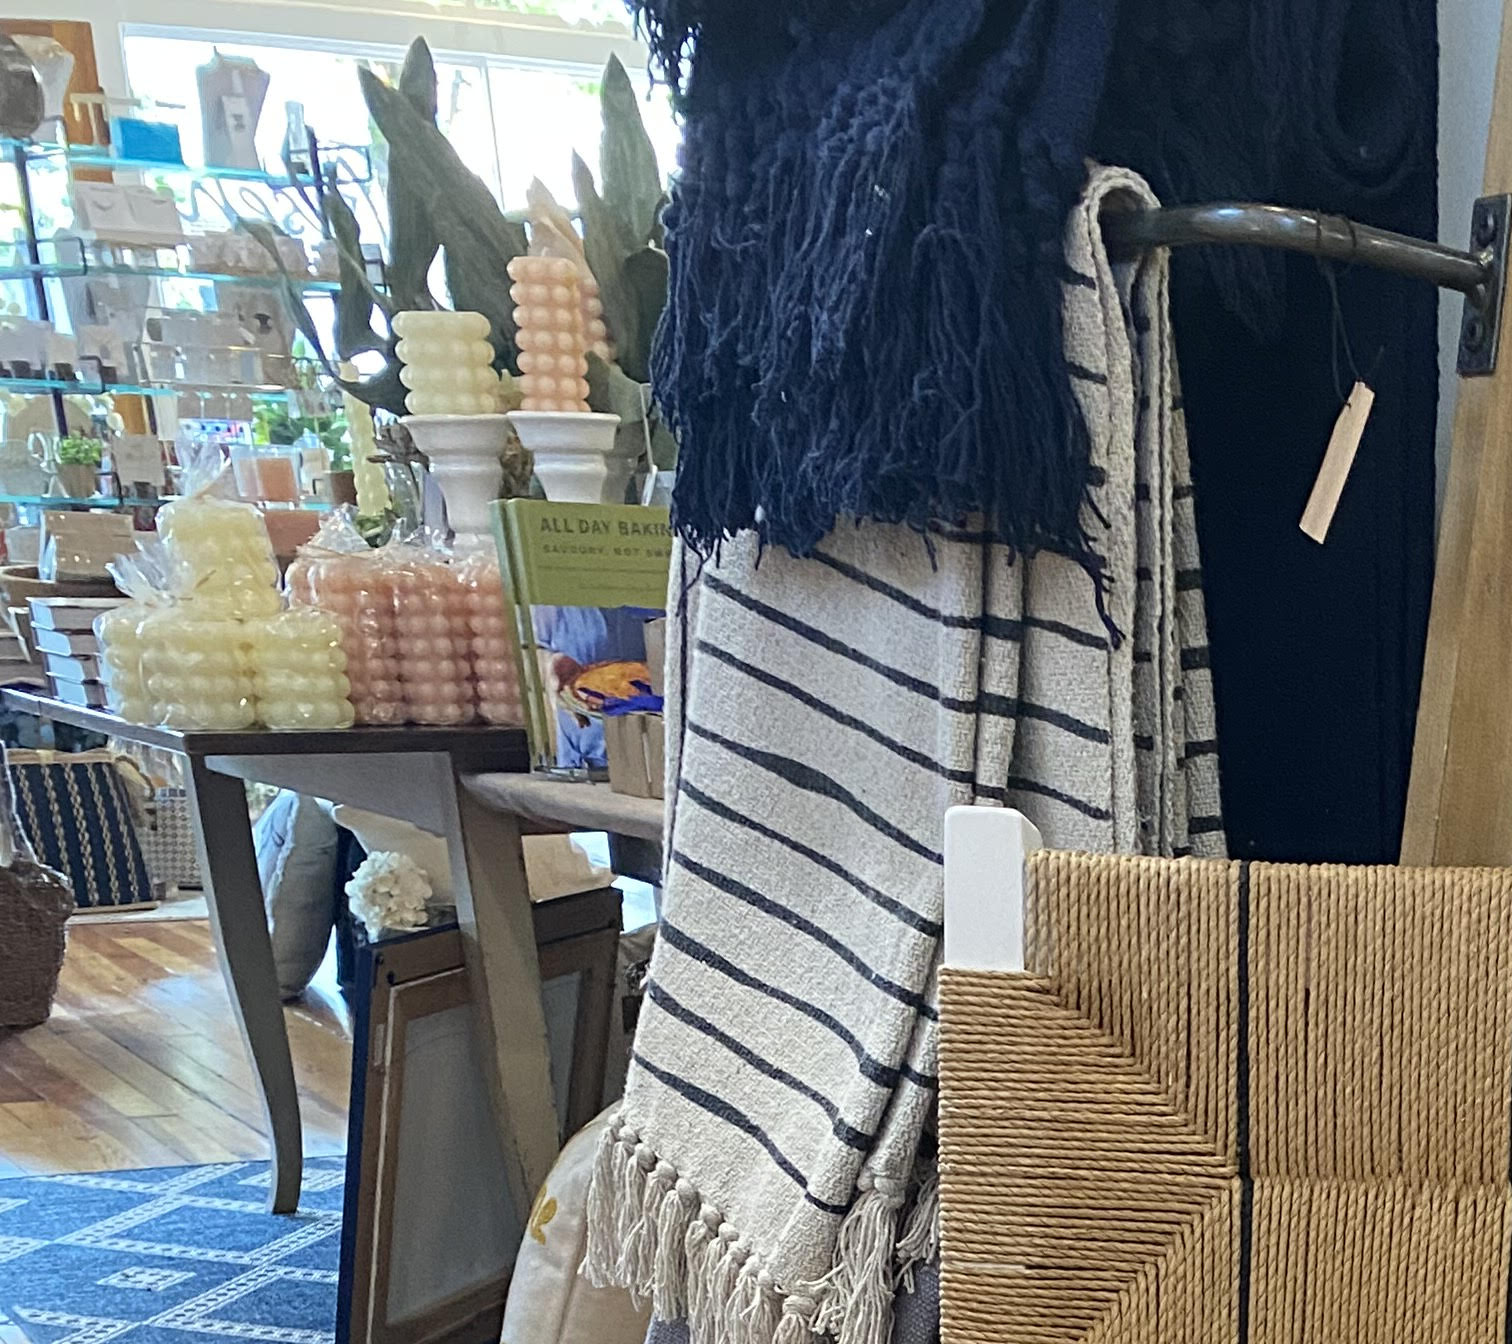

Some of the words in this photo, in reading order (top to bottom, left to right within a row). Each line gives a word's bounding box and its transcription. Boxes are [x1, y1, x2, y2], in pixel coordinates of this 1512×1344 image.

[541, 518, 574, 534] ALL
[578, 519, 610, 534] DAY
[618, 521, 674, 538] BAKIN
